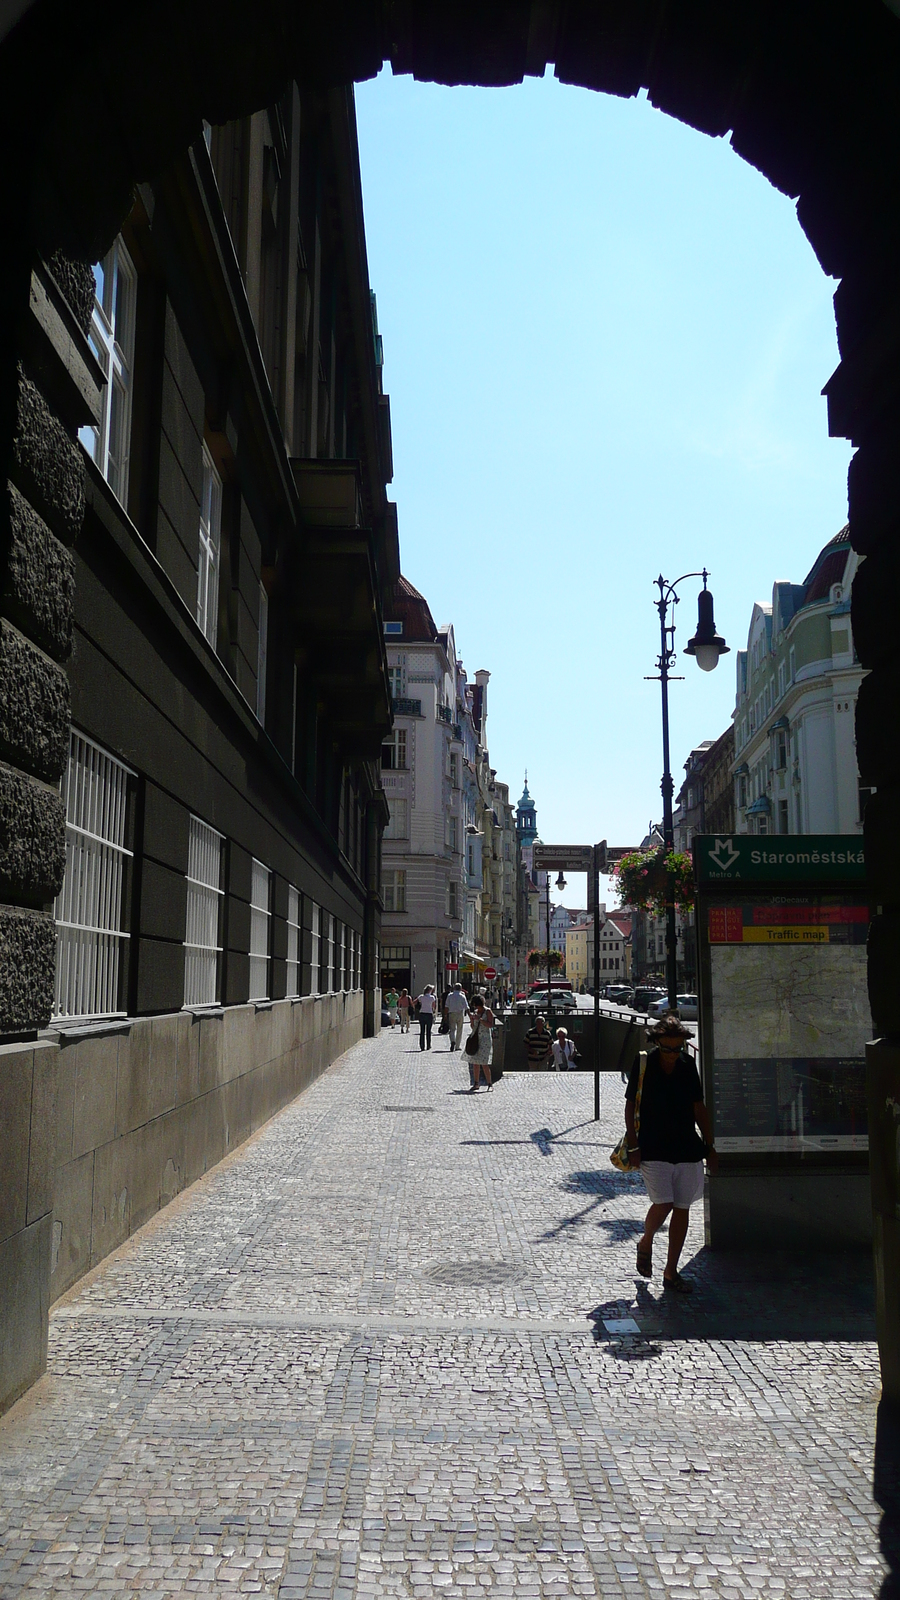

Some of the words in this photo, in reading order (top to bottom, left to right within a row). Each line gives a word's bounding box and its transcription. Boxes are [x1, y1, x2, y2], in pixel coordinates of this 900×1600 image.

[750, 850, 865, 864] Staroměstská
[767, 930, 800, 939] Traffic
[803, 931, 825, 941] map
